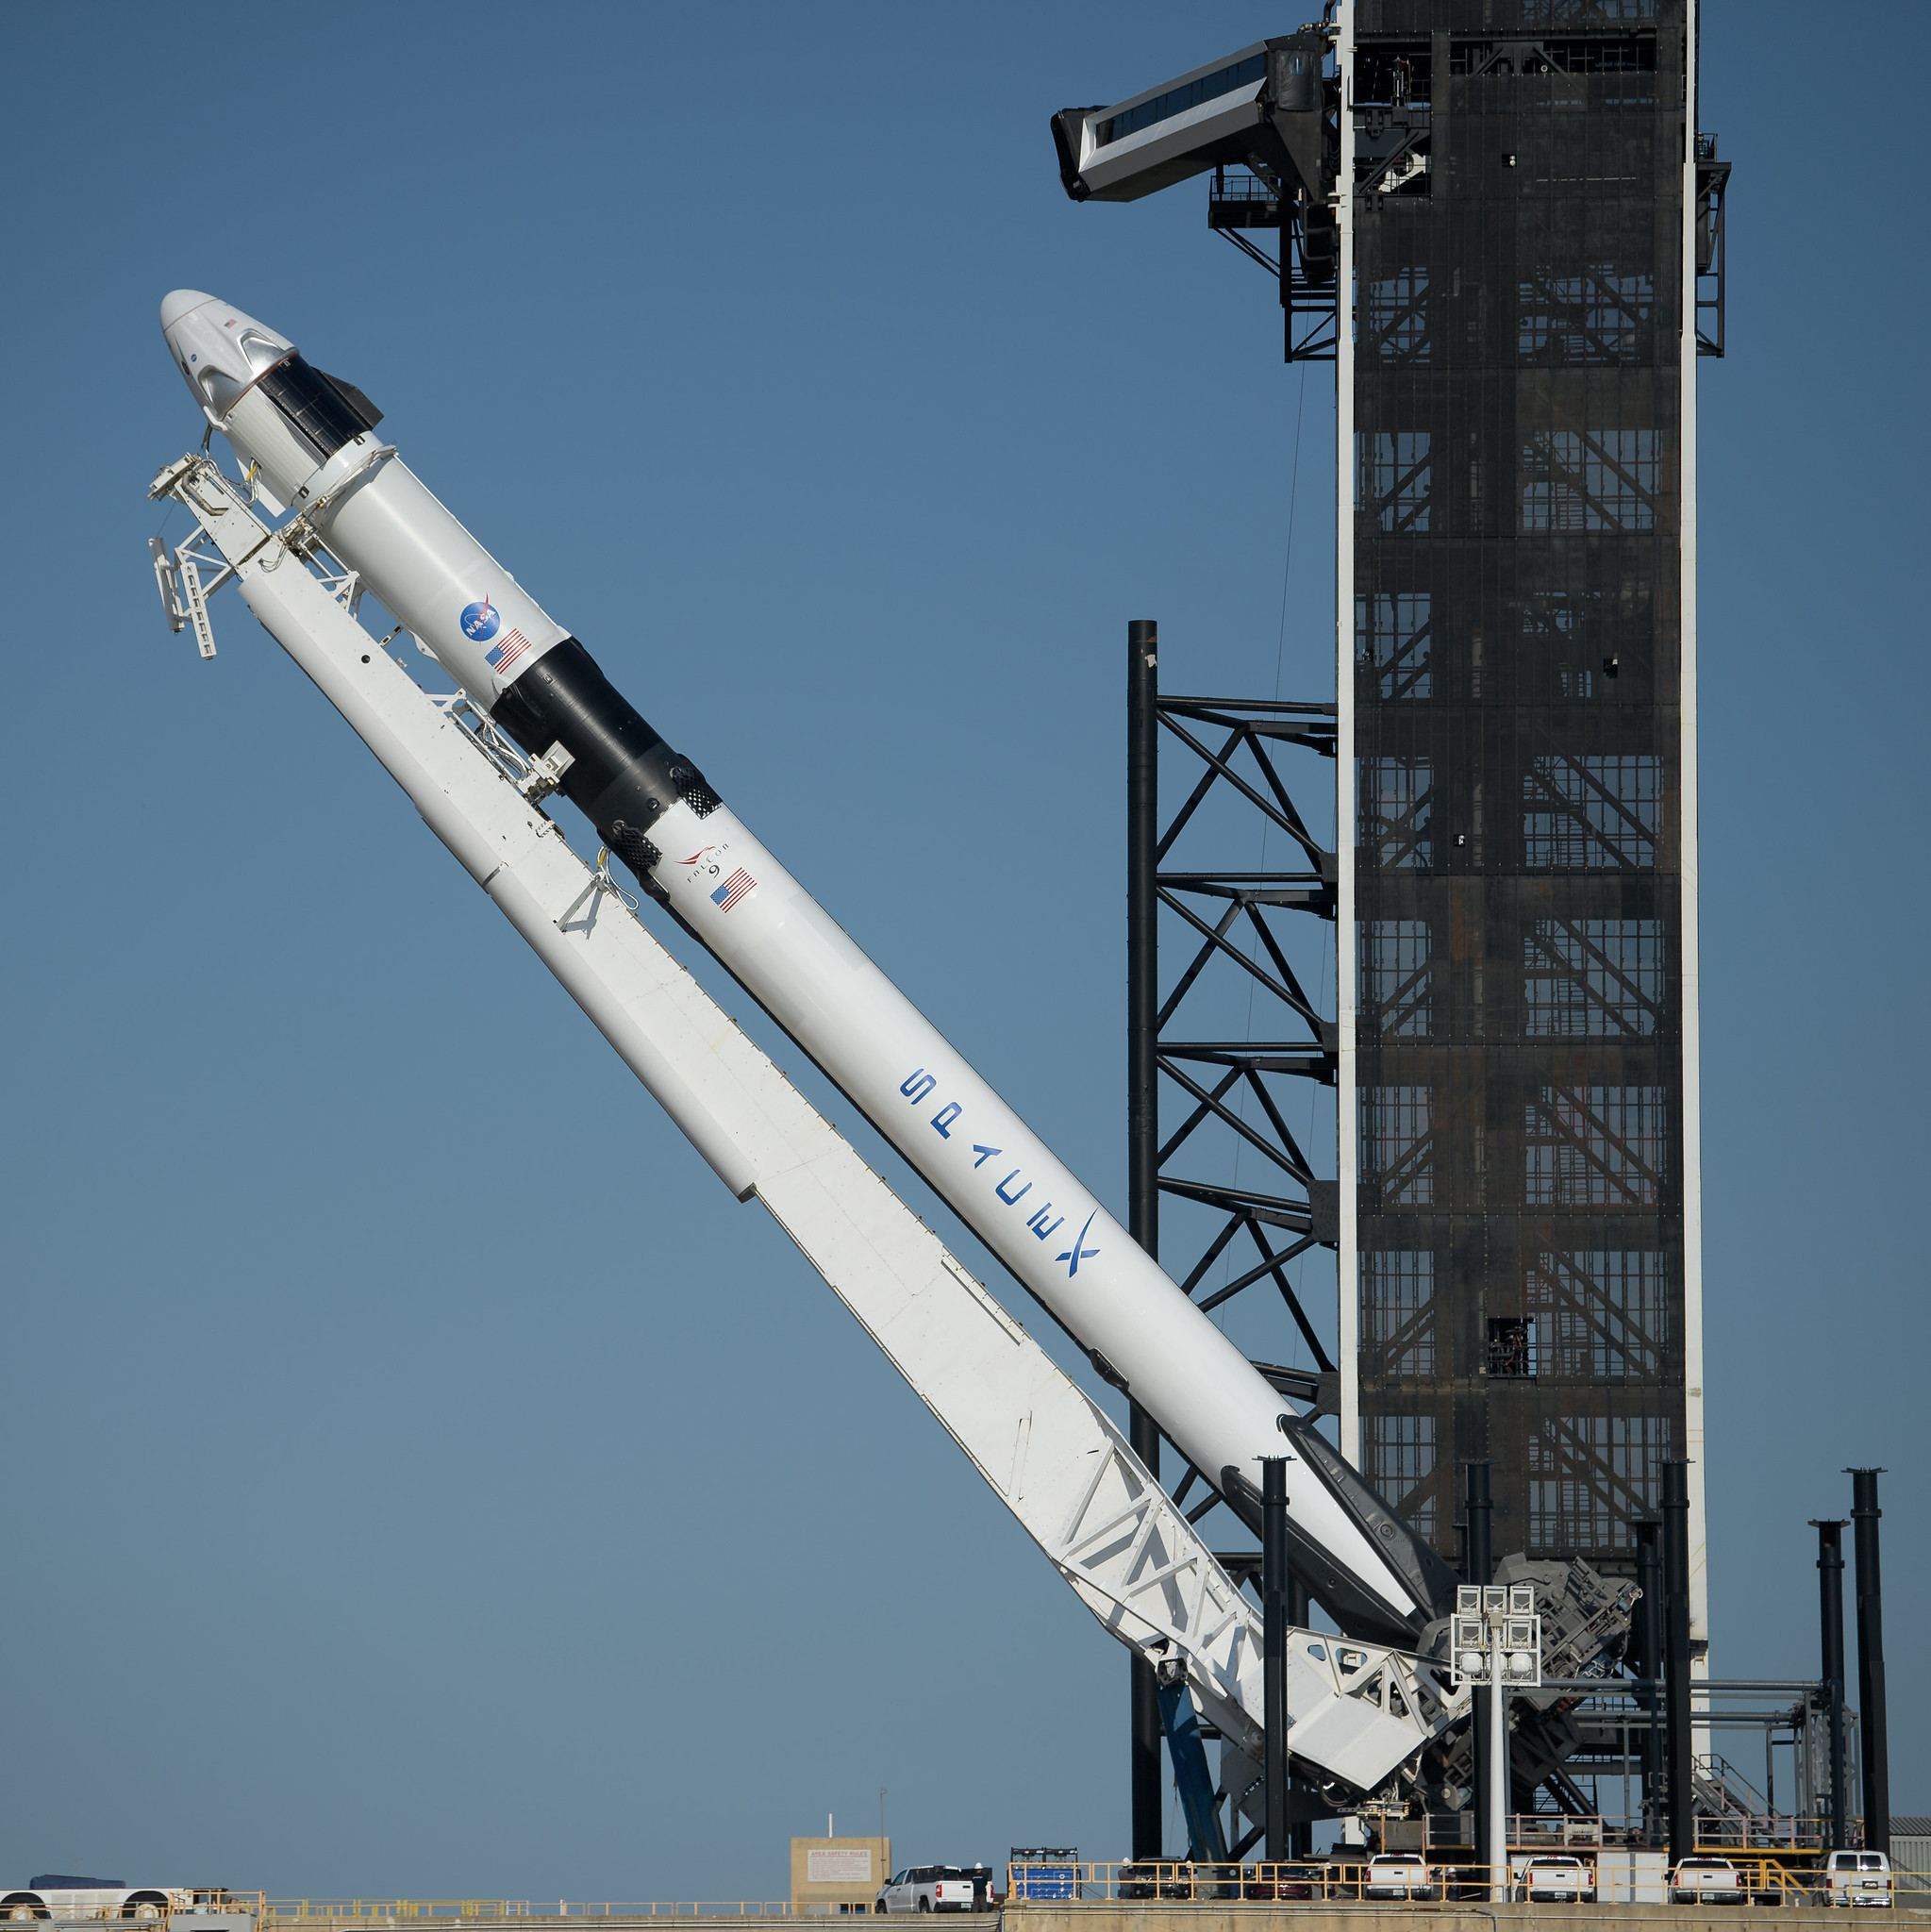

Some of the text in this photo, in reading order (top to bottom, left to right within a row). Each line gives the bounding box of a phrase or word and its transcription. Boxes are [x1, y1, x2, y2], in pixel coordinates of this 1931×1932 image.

[465, 608, 496, 636] NASA
[687, 843, 730, 884] FALCON
[708, 864, 721, 879] 9
